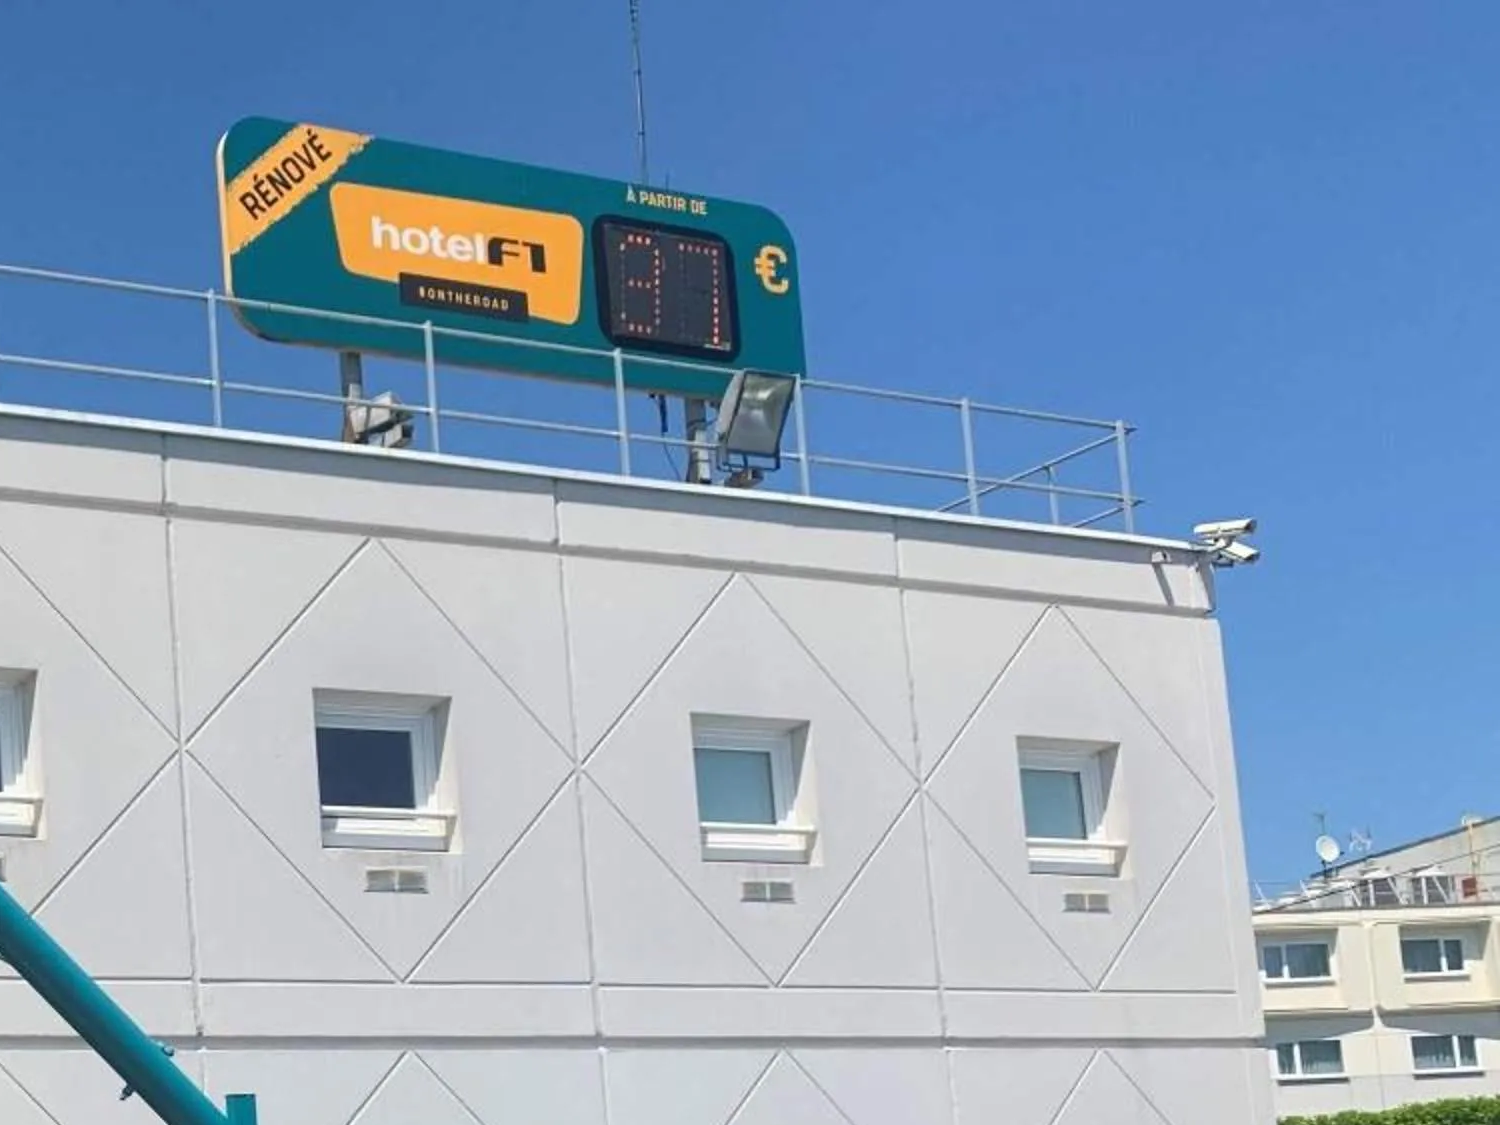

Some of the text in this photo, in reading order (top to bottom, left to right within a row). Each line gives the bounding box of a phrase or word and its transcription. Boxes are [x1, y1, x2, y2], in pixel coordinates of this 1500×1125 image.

[238, 128, 332, 220] RÉNOVÉ
[626, 185, 708, 215] À PARTIR DE
